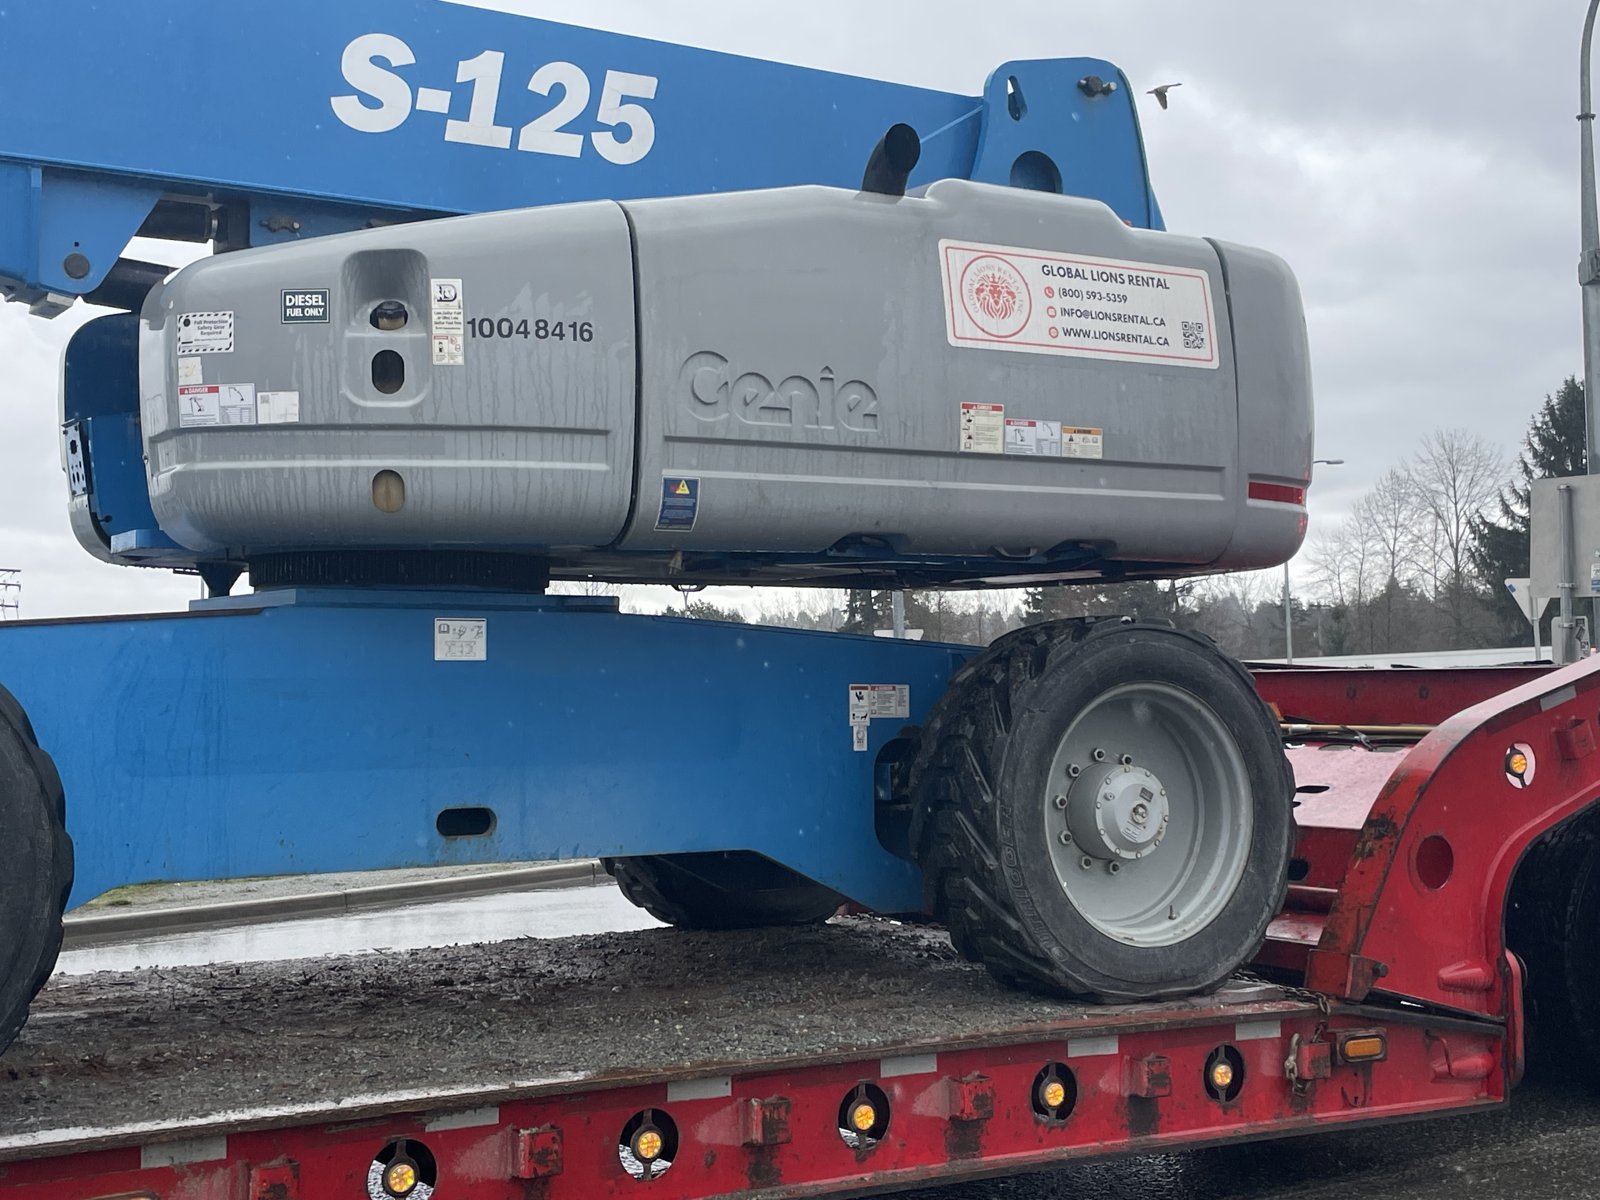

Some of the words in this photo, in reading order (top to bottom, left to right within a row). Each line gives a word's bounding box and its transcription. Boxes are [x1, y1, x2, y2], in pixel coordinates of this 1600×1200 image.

[330, 33, 659, 165] S-125
[1041, 264, 1088, 280] GLOBAL
[1090, 269, 1126, 285] LIONS
[1127, 274, 1171, 290] RENTAL
[285, 294, 325, 306] DIESEL
[1058, 287, 1084, 301] (800)
[1086, 290, 1128, 304] 593-5359
[286, 308, 303, 317] FUEL
[304, 307, 324, 317] ONLY
[1060, 307, 1166, 327] INFO@LIONSRENTAL.CA
[466, 317, 594, 342] 10048416
[1062, 327, 1170, 347] WWW.LIONSRENTAL.CA
[679, 350, 878, 432] Genie
